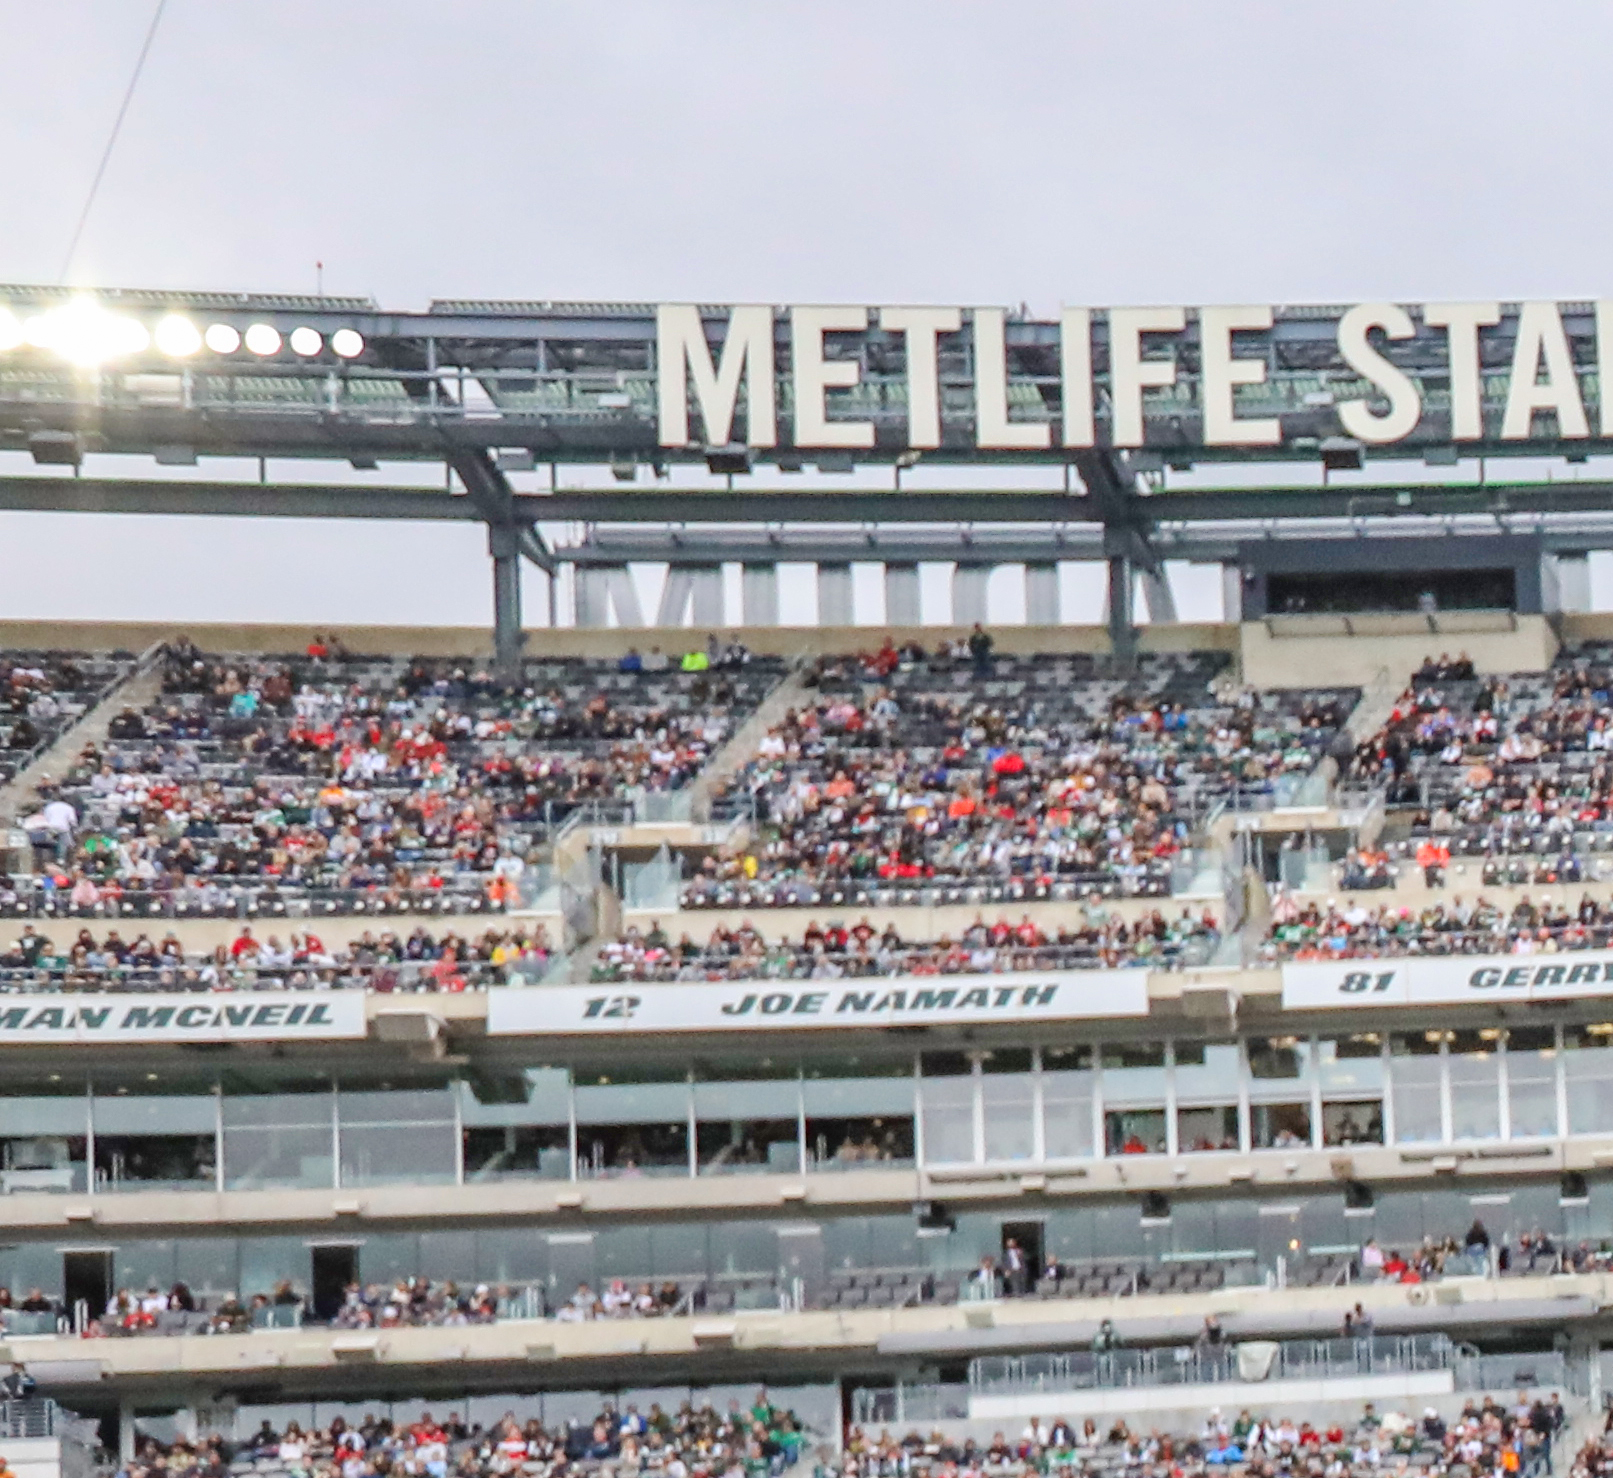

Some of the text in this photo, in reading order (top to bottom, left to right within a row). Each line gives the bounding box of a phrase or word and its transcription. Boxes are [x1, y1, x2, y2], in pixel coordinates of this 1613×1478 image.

[655, 302, 1281, 450] METLIFE
[1338, 971, 1396, 993] 81
[120, 1001, 335, 1029] MCNEIL
[582, 984, 1059, 1019] 12 JOE NAMATH
